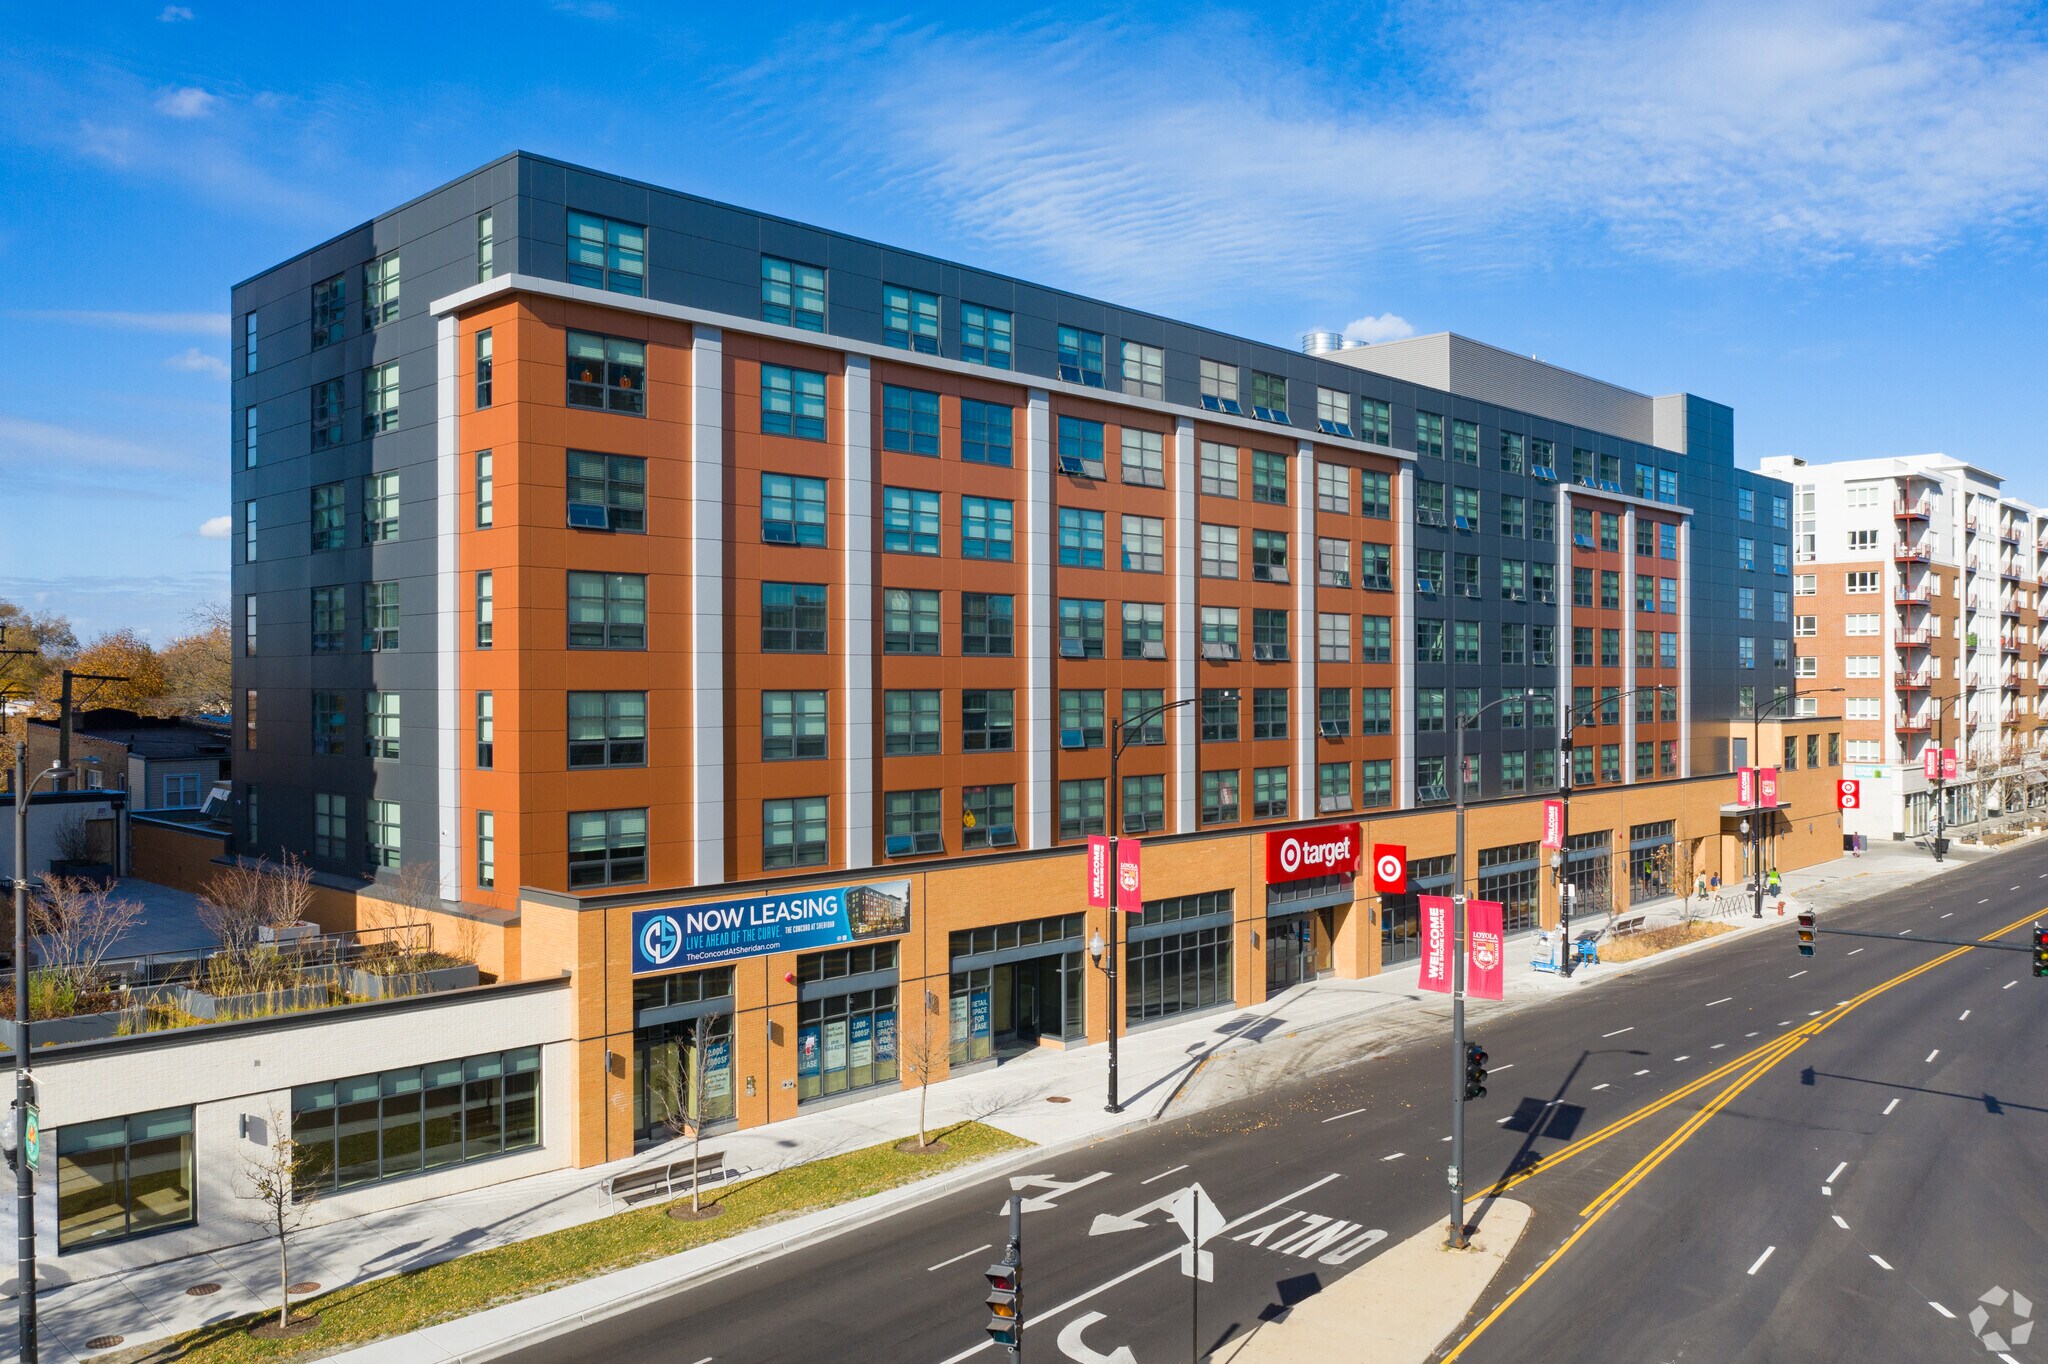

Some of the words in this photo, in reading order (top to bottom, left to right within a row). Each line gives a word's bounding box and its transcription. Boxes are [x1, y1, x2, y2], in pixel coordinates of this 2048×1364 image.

[1302, 836, 1350, 867] target
[686, 906, 744, 934] NOW
[750, 896, 838, 924] LEASING
[686, 936, 704, 950] LIVE
[706, 933, 730, 947] AHEAD
[731, 932, 741, 944] OF
[743, 929, 756, 942] THE
[758, 926, 782, 940] CURVE.
[1428, 908, 1439, 978] WELCOME
[1473, 932, 1498, 940] LOYOLA
[686, 942, 780, 961] TheConcordAtSheridan.com
[972, 999, 988, 1008] RETAIL
[972, 1007, 987, 1016] SPACE
[799, 1060, 818, 1070] LEASE
[1232, 1211, 1388, 1264] ONLY
